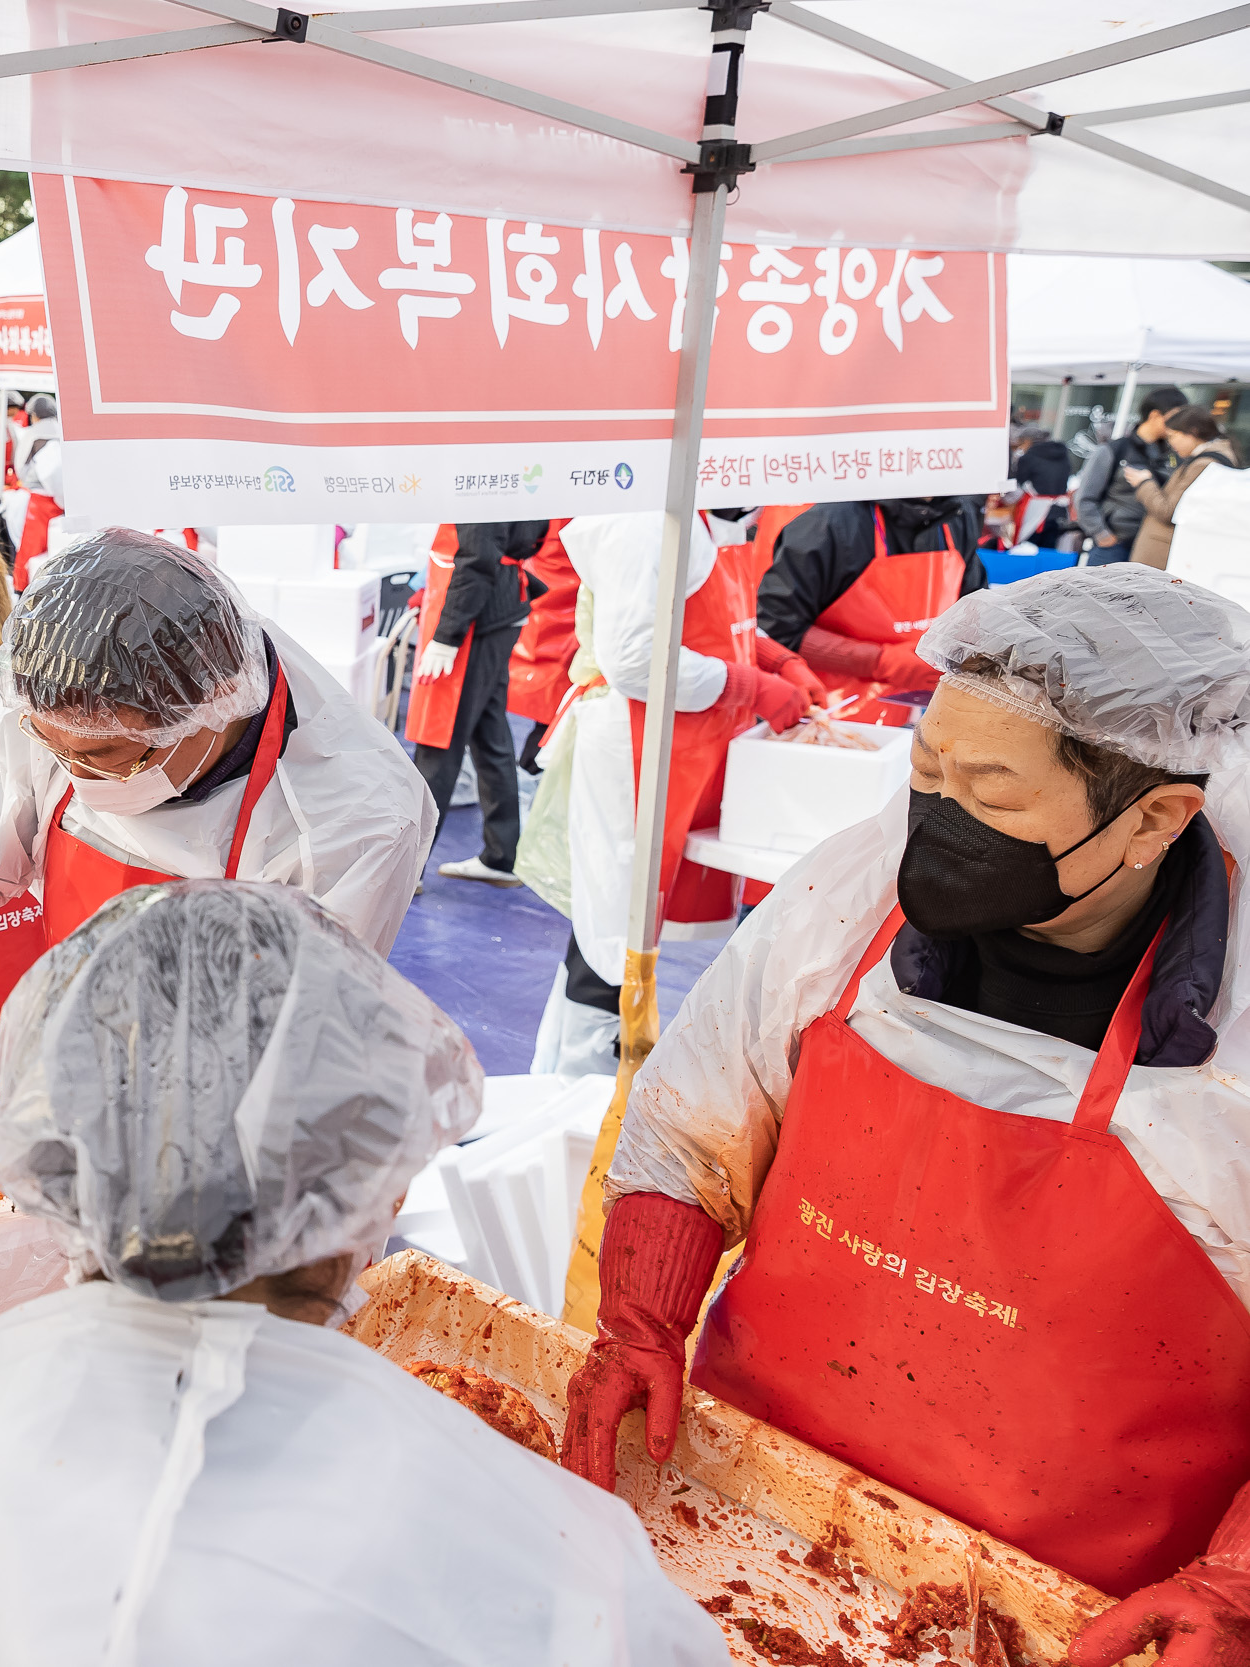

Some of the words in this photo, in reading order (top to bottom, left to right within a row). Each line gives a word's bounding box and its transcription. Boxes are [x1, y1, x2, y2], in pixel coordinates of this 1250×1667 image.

[798, 1197, 834, 1240] 광진
[838, 1230, 907, 1279] 사랑의
[914, 1266, 1019, 1329] 김장축제!
